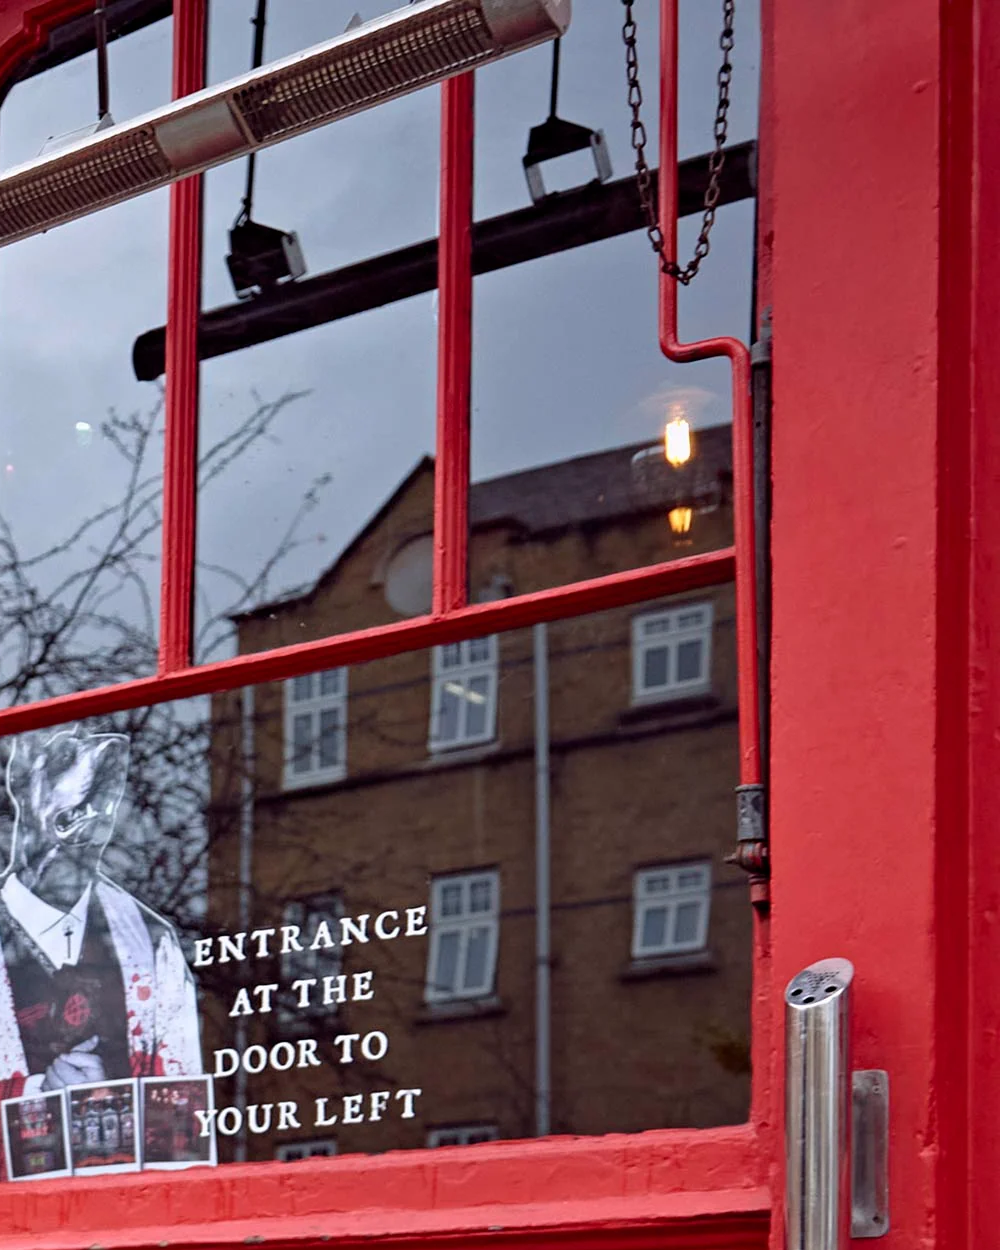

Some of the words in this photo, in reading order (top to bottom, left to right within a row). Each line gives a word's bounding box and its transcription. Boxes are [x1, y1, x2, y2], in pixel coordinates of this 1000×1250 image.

[193, 905, 428, 967] ENTRANCE
[229, 983, 278, 1017] AT
[292, 971, 375, 1008] THE
[213, 1038, 321, 1078] DOOR
[334, 1030, 389, 1063] TO
[193, 1101, 302, 1138] YOUR
[314, 1088, 422, 1127] LEFT
